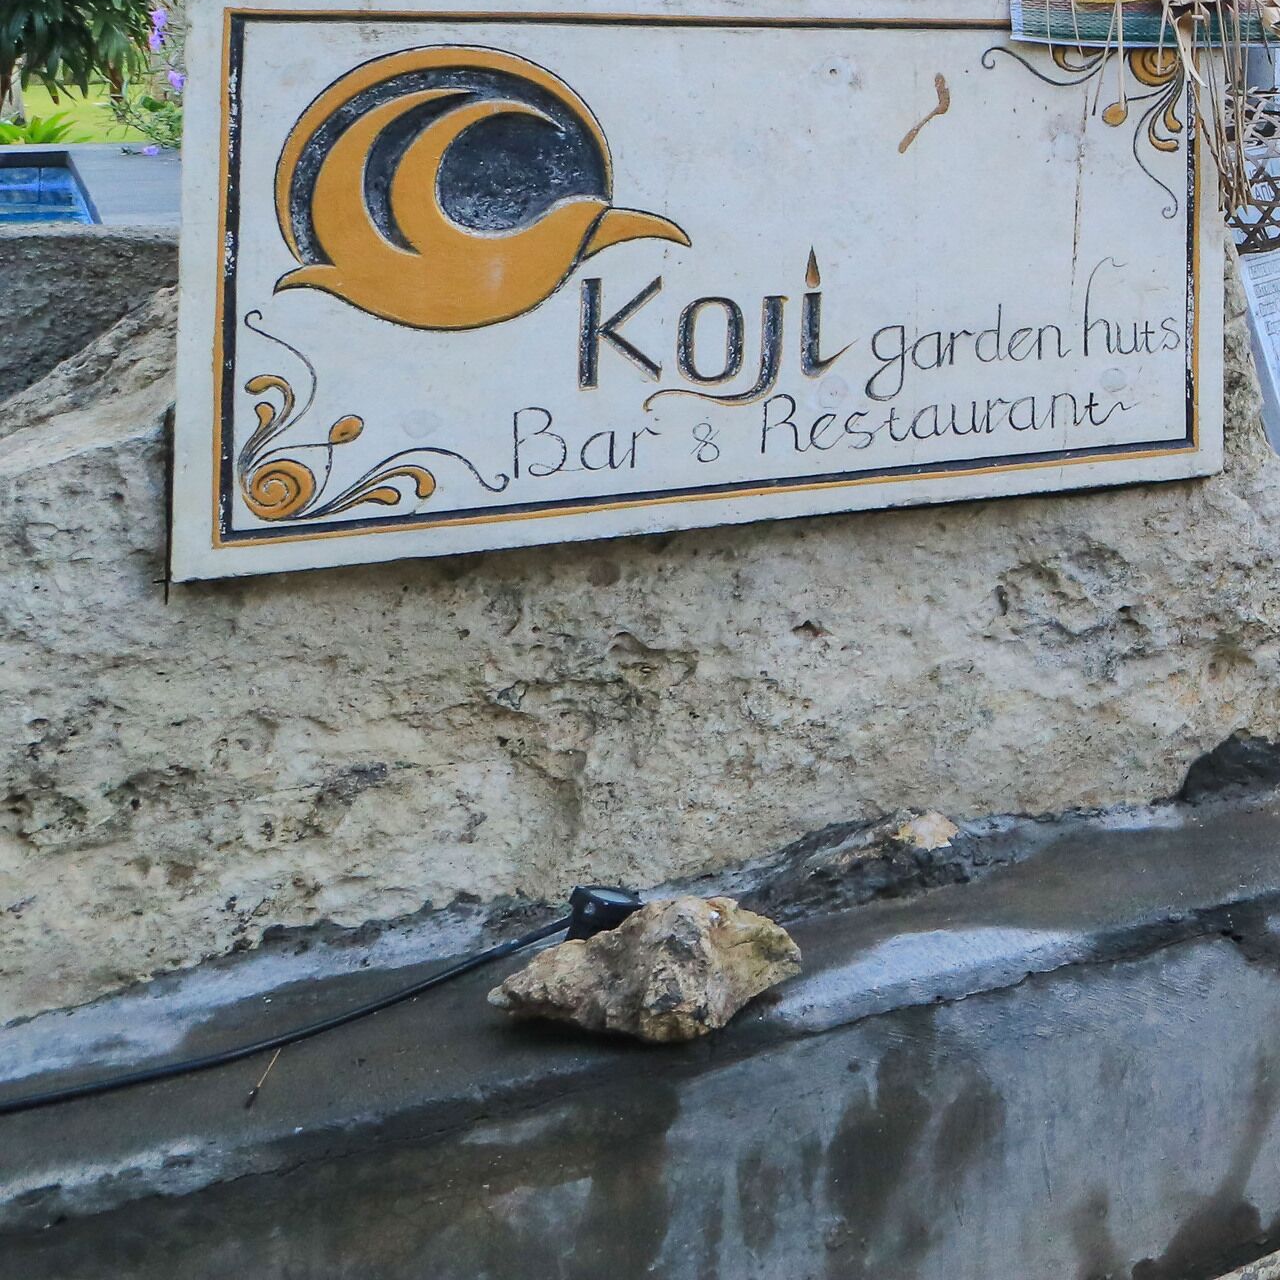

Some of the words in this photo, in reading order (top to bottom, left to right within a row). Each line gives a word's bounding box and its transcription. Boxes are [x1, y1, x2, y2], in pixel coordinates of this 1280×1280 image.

[864, 303, 1071, 402] garden
[1083, 256, 1182, 358] huts
[513, 406, 661, 480] Bar
[760, 393, 1140, 454] Restaurant
